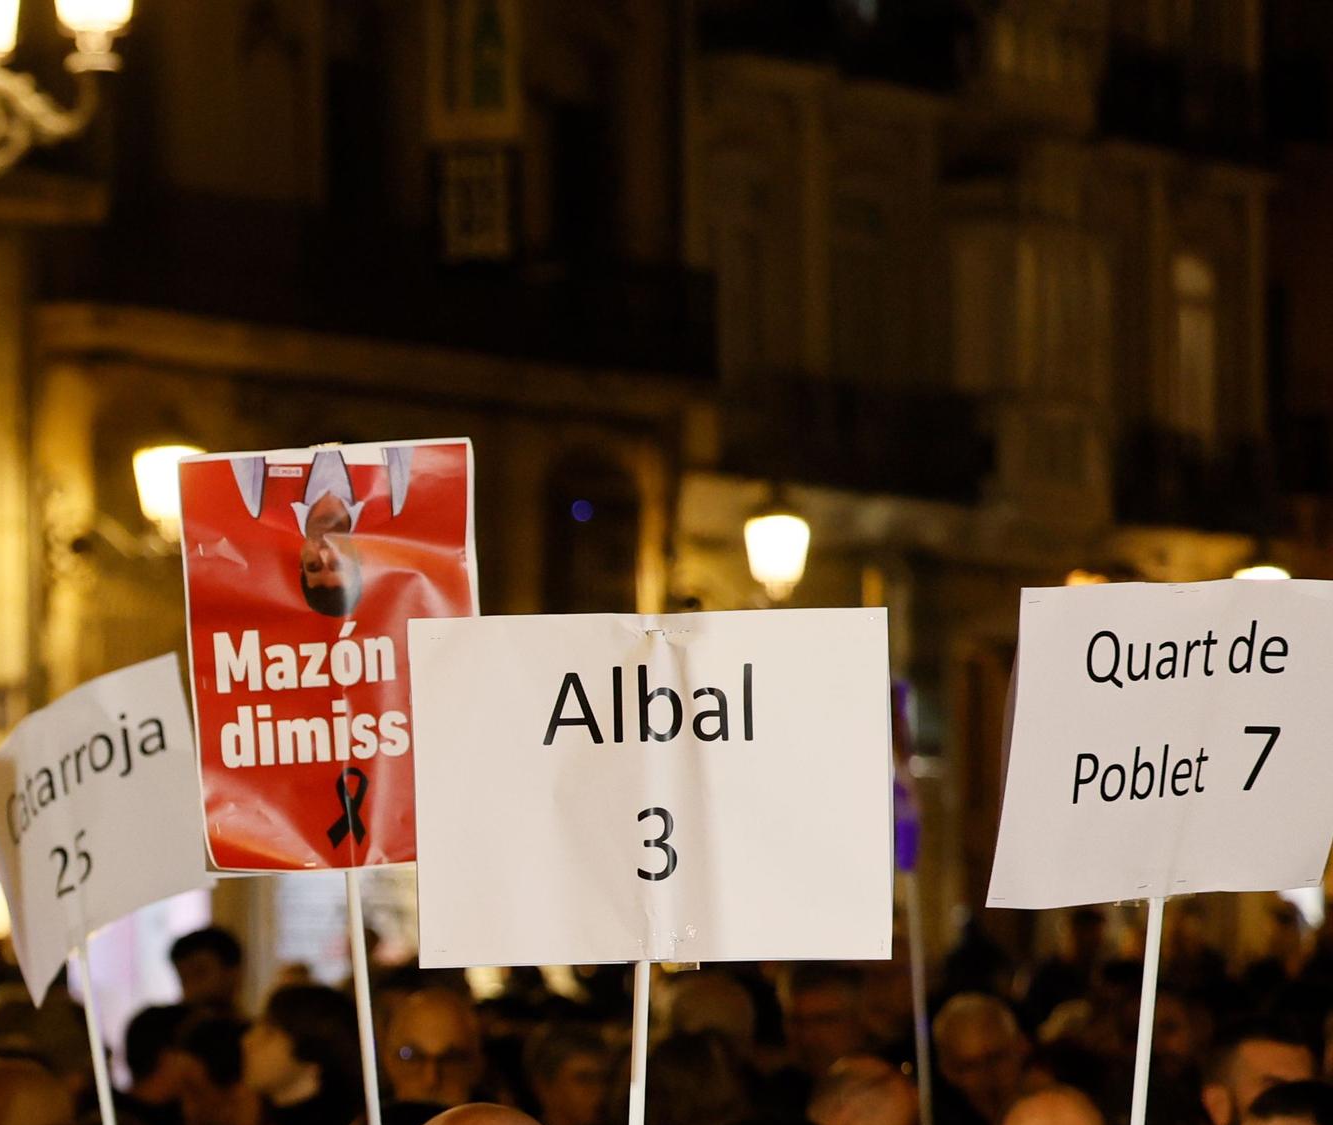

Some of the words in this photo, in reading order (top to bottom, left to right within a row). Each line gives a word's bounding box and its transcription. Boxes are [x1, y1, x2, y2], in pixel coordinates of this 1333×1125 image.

[214, 622, 396, 693] Mazón
[1087, 630, 1218, 688] Quart
[1229, 620, 1288, 674] de
[221, 702, 409, 767] dimiss
[543, 664, 754, 745] Albal
[6, 713, 166, 845] Catarroja
[1073, 744, 1209, 804] Poblet
[1243, 726, 1281, 791] 7
[49, 829, 92, 898] 25
[637, 807, 677, 881] 3
